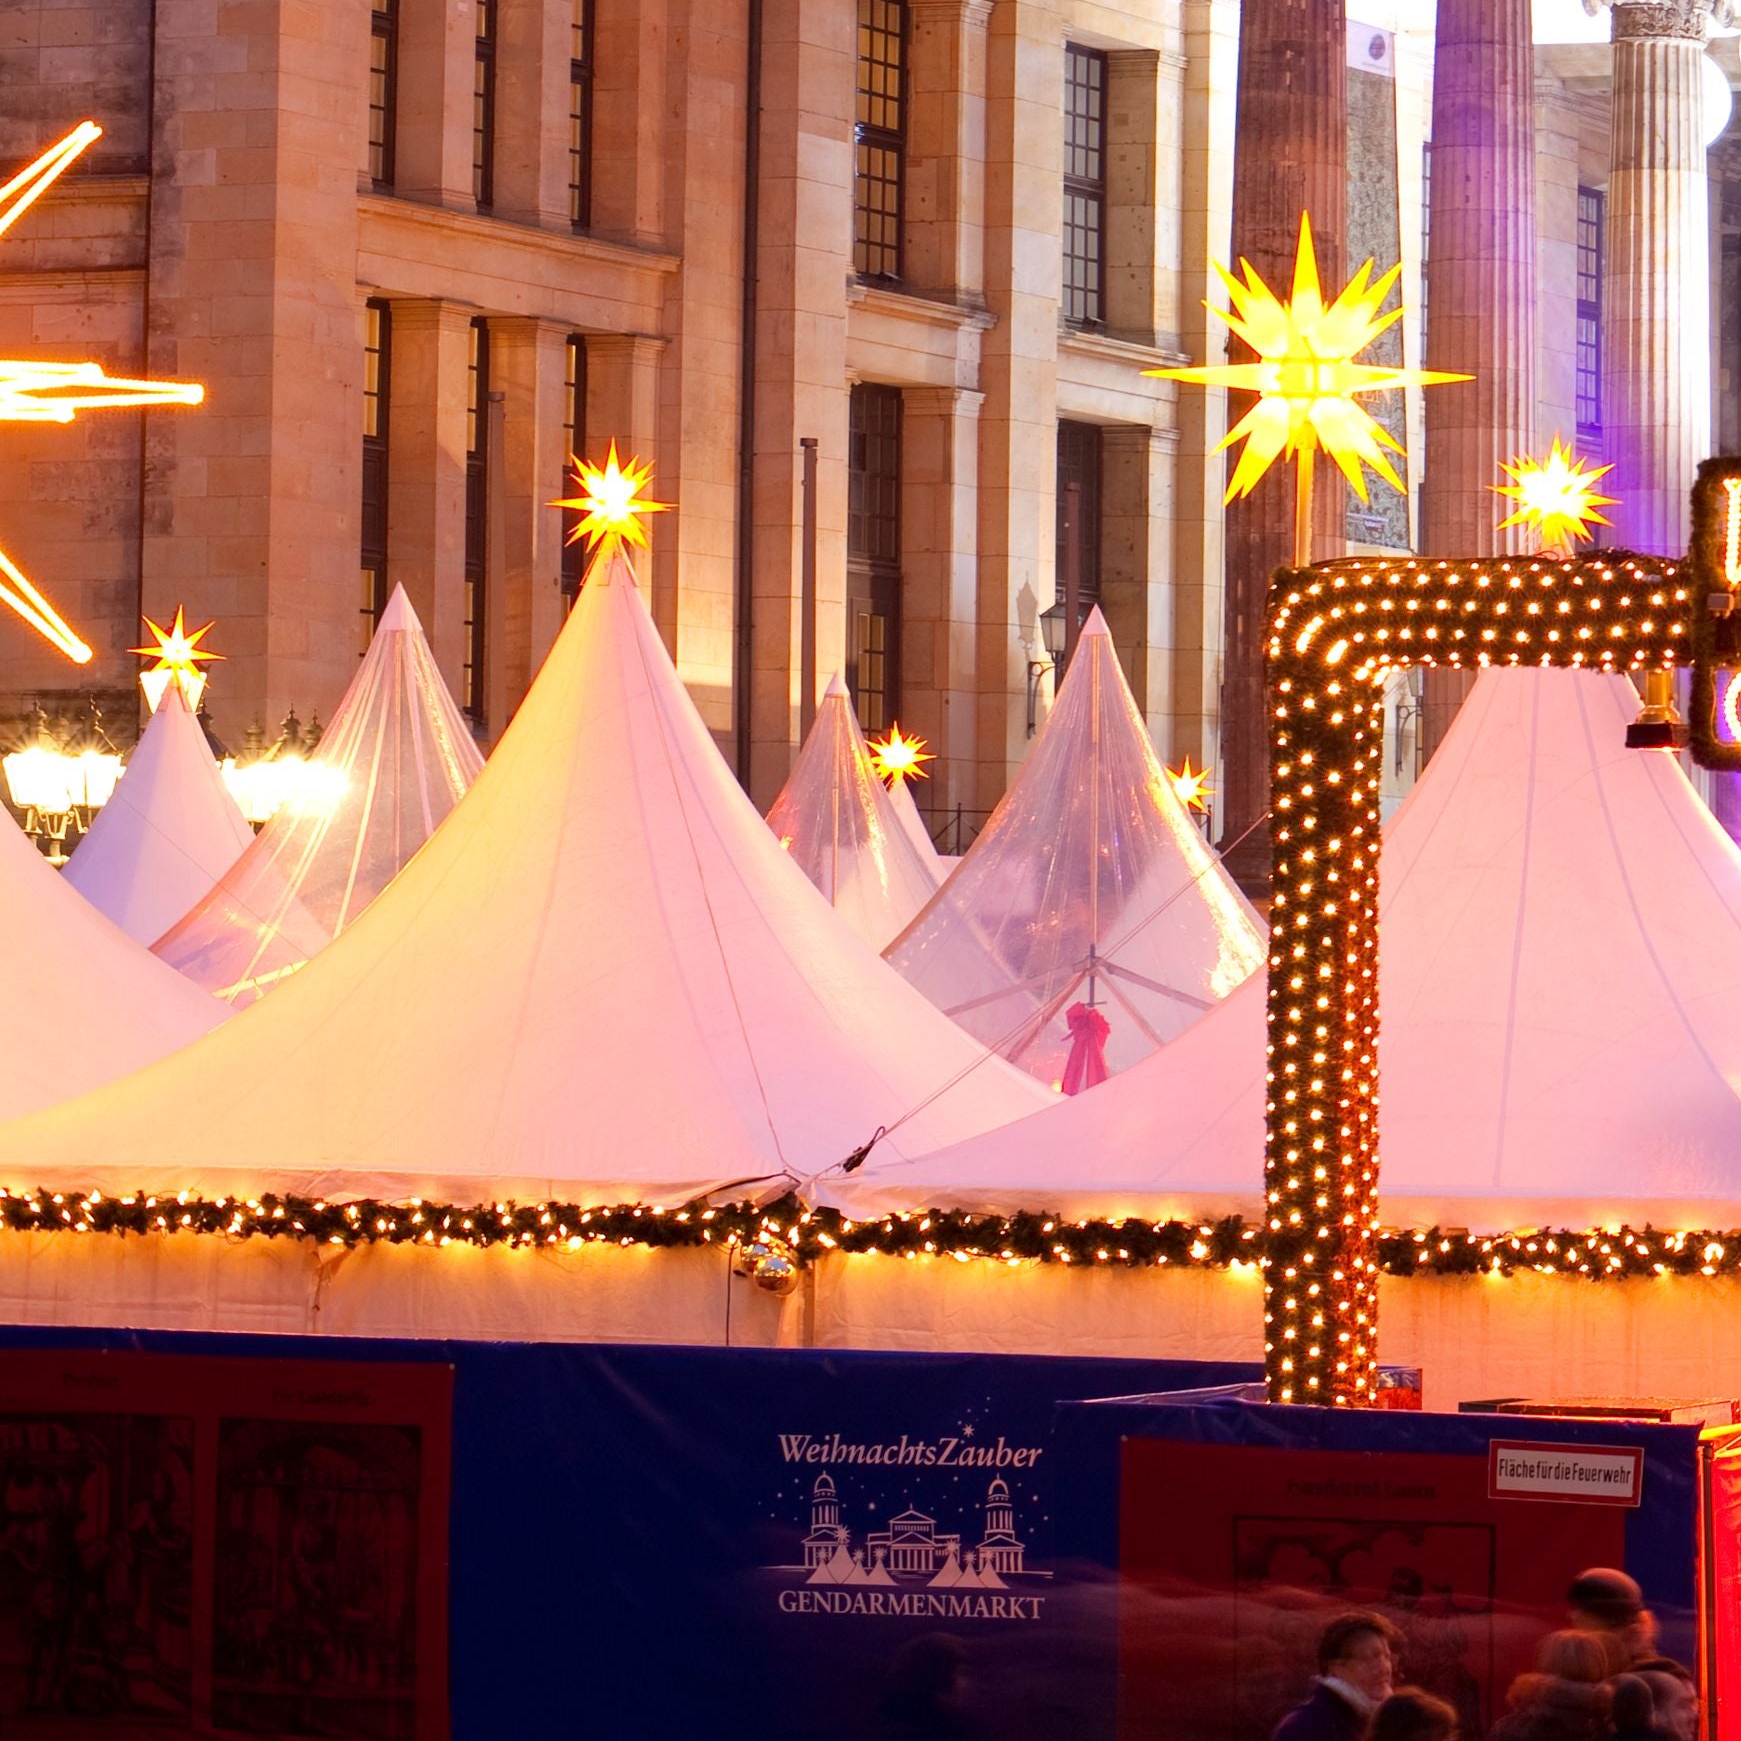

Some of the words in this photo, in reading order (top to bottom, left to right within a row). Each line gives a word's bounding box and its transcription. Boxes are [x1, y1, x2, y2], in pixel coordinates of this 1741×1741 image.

[778, 1433, 1043, 1468] WeihnachtsZauber
[1499, 1458, 1535, 1479] Fläche
[1536, 1461, 1553, 1480] für
[1554, 1462, 1571, 1481] die
[1572, 1463, 1632, 1485] Feuerwehr
[778, 1590, 1045, 1620] GENDARMENMARKT
